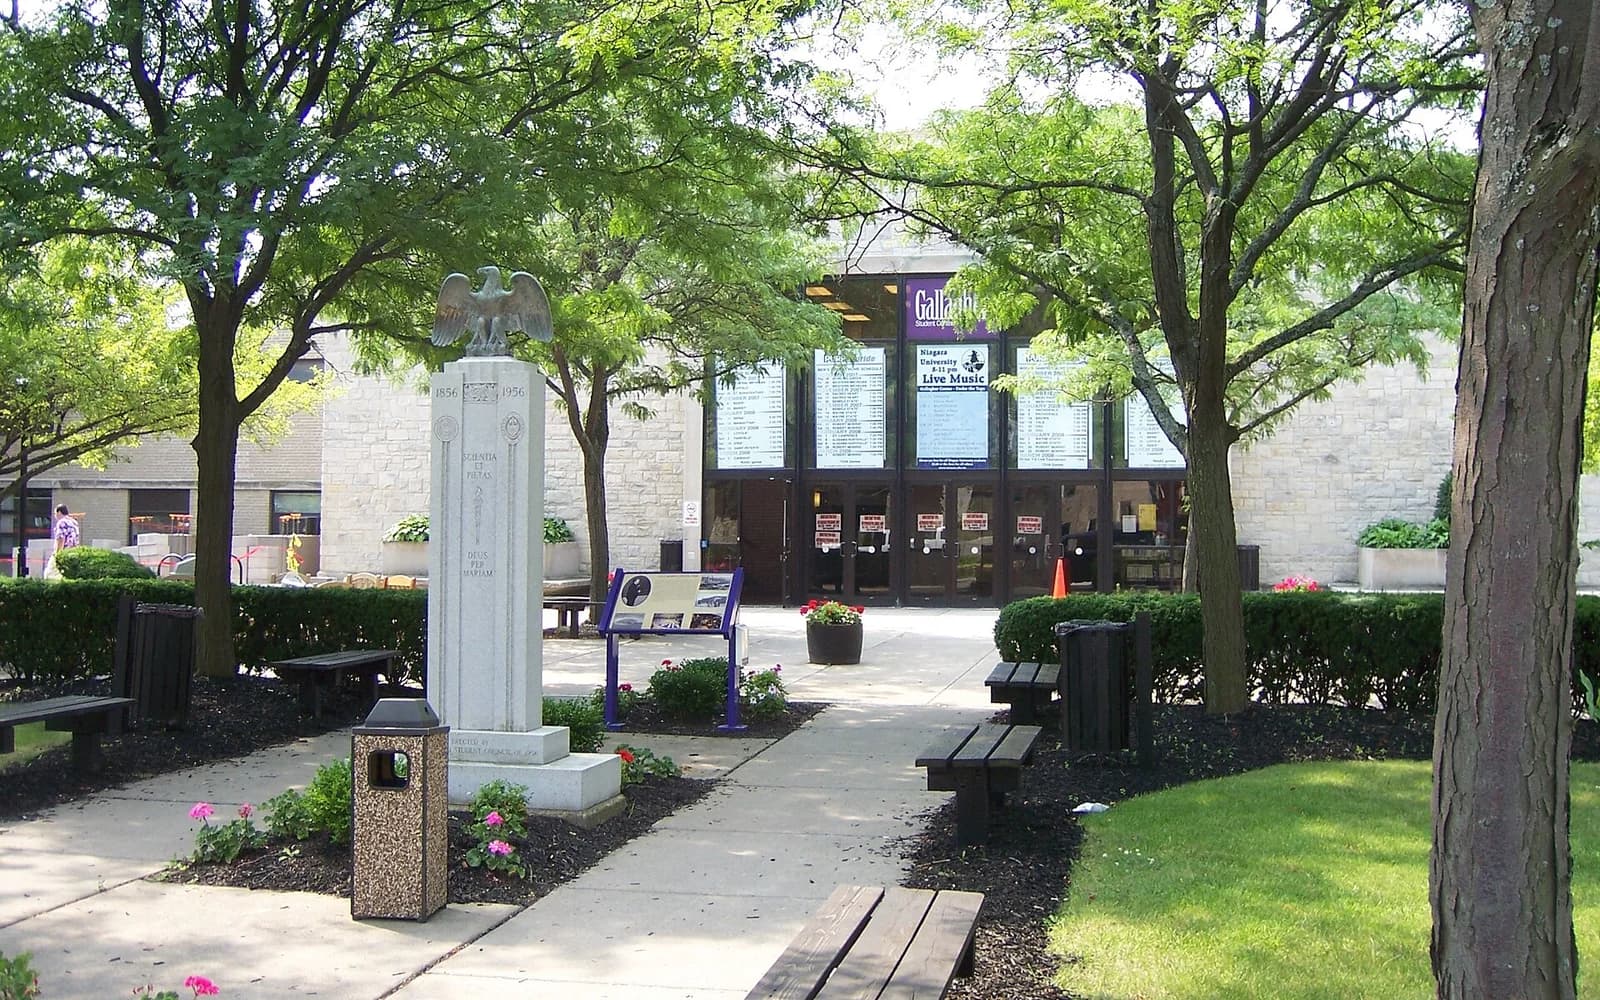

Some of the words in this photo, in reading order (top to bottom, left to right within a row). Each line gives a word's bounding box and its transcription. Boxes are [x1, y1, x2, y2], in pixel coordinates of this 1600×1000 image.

[920, 359, 957, 367] University
[922, 374, 946, 384] Live
[949, 374, 985, 384] Music
[435, 387, 458, 398] 1856
[502, 386, 525, 397] 1956
